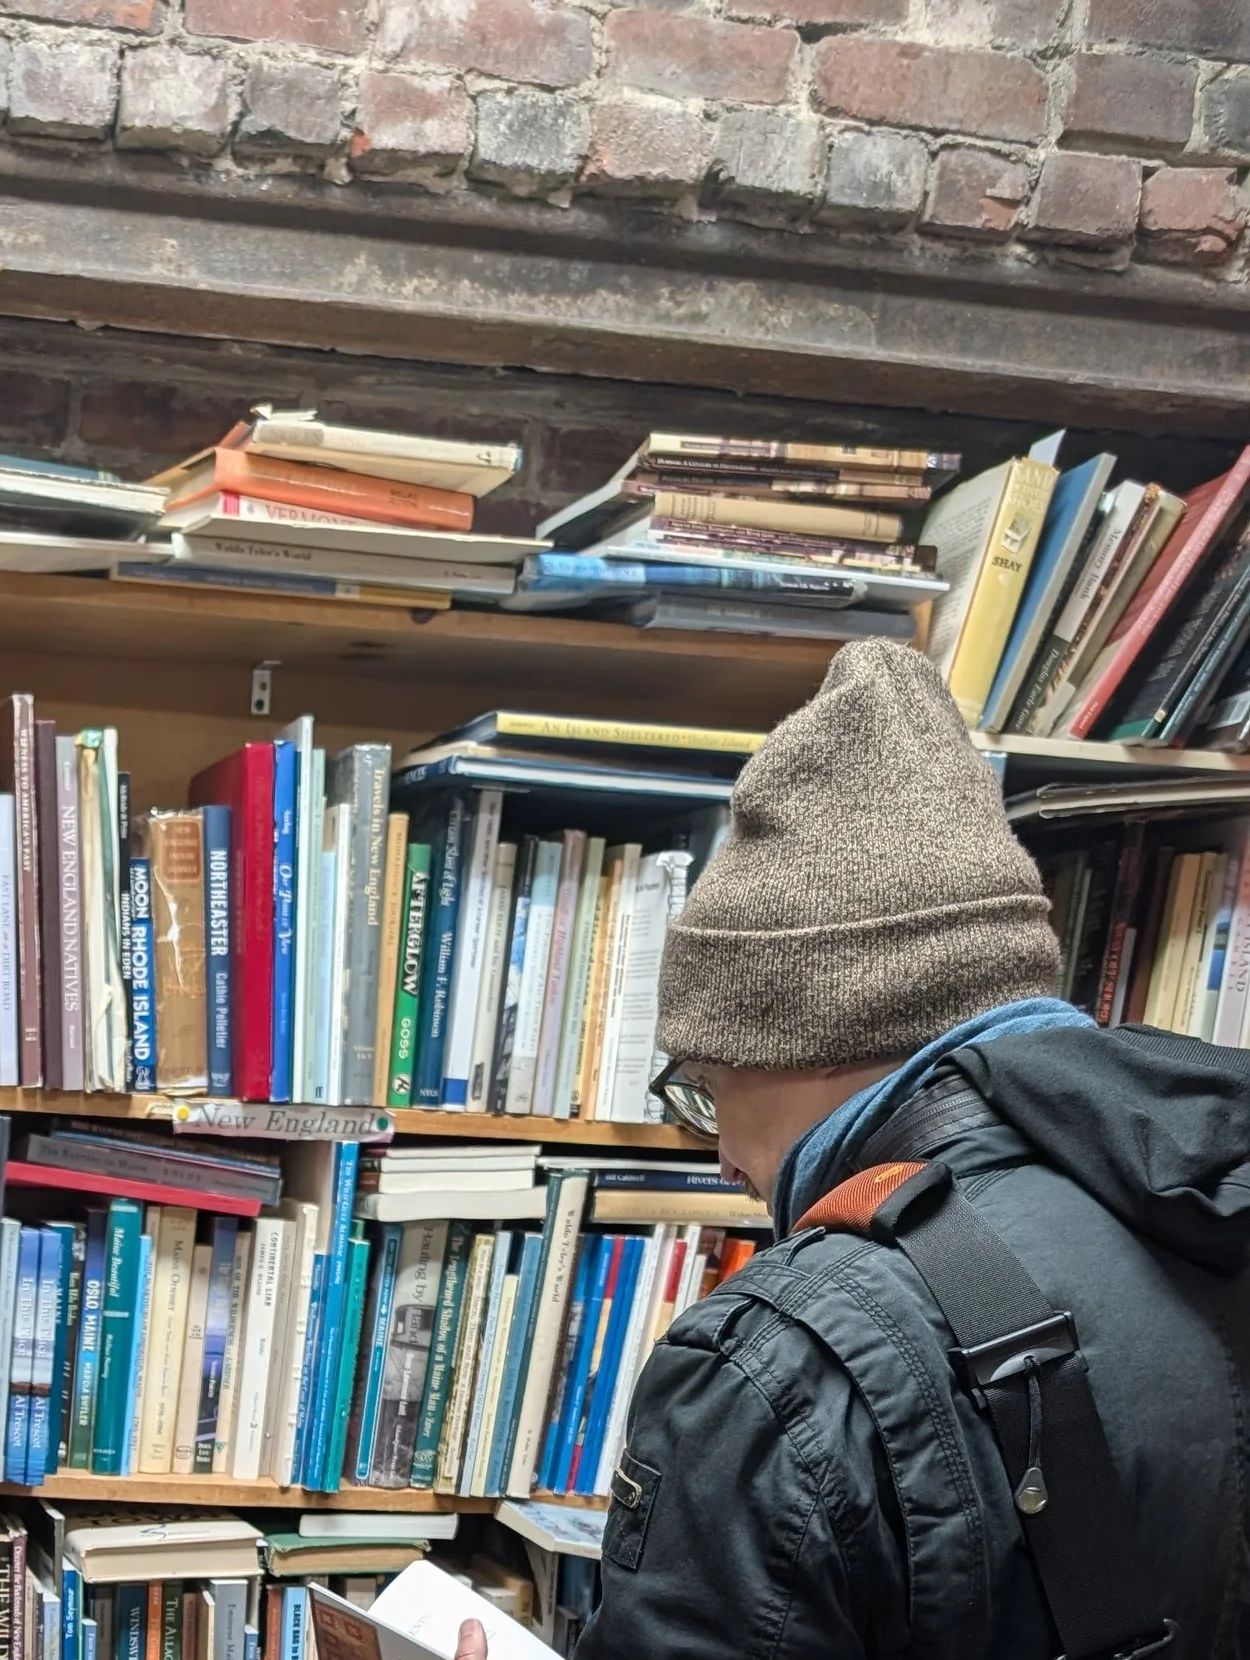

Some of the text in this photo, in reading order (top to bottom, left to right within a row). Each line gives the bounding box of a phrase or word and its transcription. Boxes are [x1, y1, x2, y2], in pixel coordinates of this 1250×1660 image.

[992, 556, 1022, 572] SHAY
[1079, 528, 1123, 600] Memory Bank
[542, 722, 682, 744] AN ISLAND SHELTERED
[367, 767, 385, 925] Travels in New England
[61, 805, 78, 1011] NEW ENGLAND NATIVES
[131, 867, 149, 1060] MOON RHODE ISLAND
[210, 850, 230, 1049] NORTHEASTER Cathie Pelletier
[398, 870, 427, 1059] AFTERGLOW GOSS
[193, 1105, 375, 1137] New England
[108, 1227, 125, 1297] Maine Beautiful
[165, 1598, 178, 1623] THE
[226, 1603, 236, 1640] Eminent
